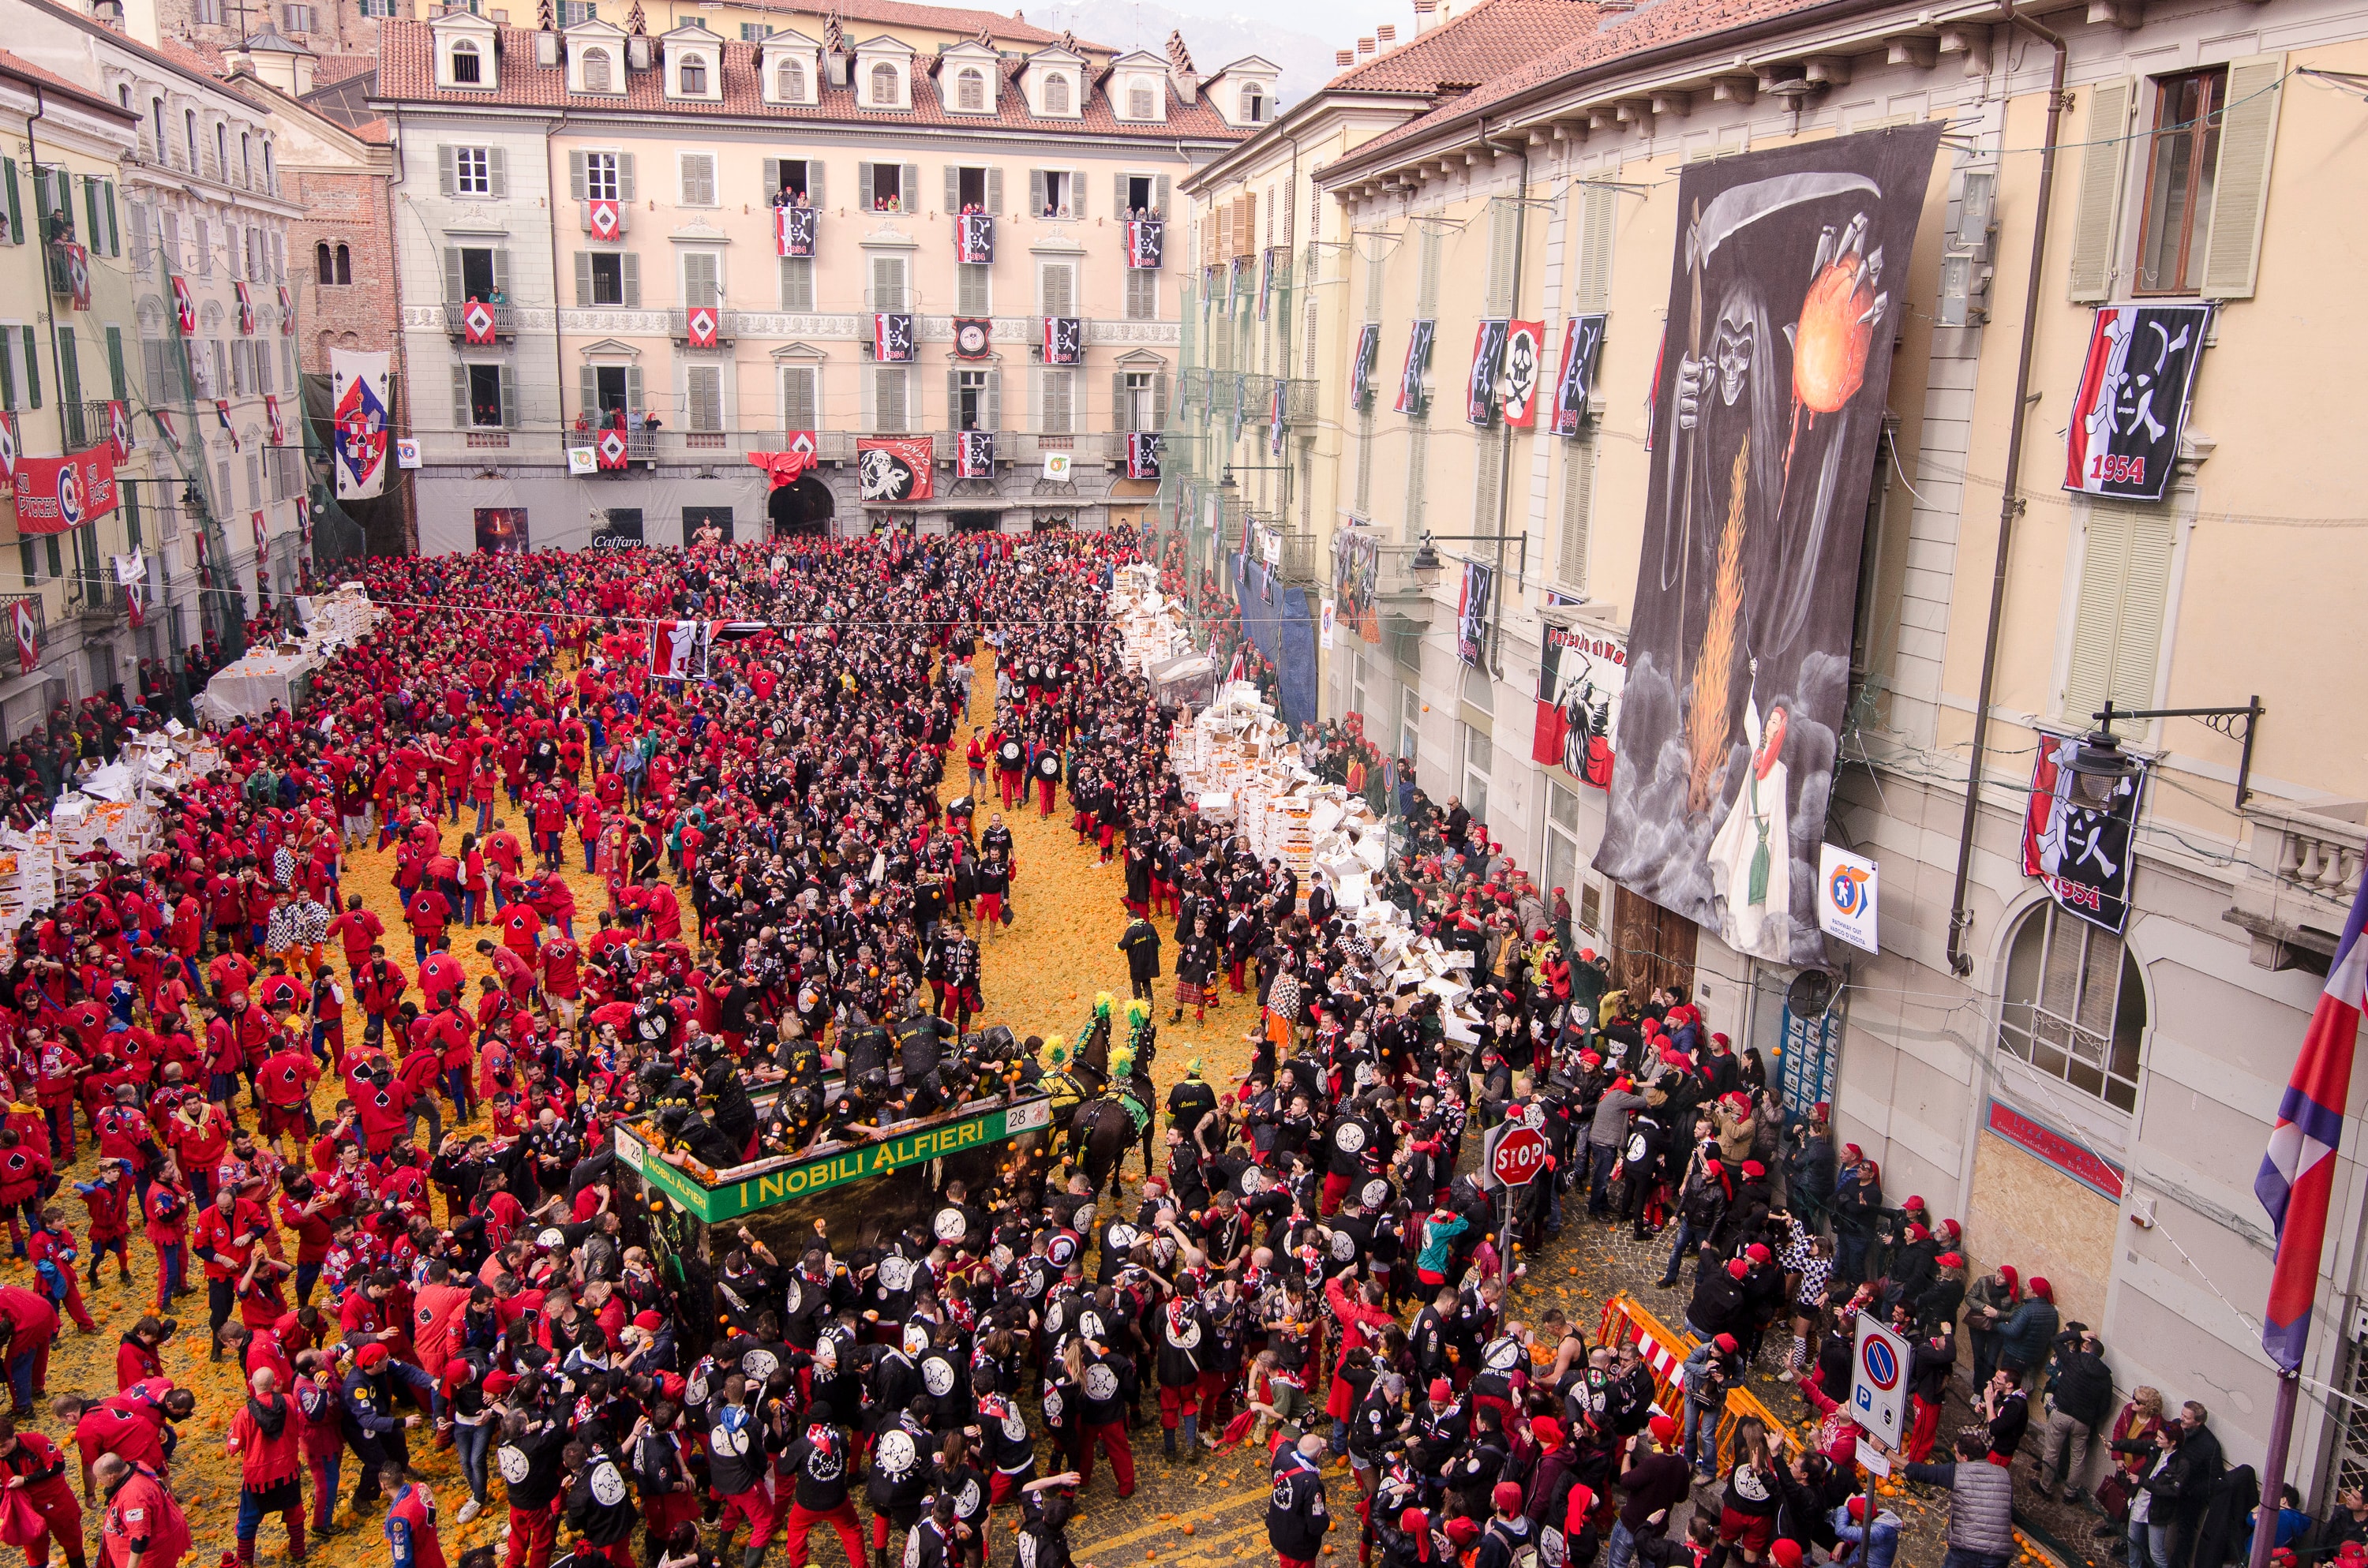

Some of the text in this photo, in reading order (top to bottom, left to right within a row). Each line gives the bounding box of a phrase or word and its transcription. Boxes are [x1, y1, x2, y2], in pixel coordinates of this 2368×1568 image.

[787, 245, 807, 254] 1954
[967, 253, 986, 261] 1954
[886, 350, 905, 359] 1954
[1560, 410, 1578, 428] 1954
[895, 442, 931, 466] FONDO
[901, 452, 927, 485] PIAZZA
[2090, 455, 2145, 485] 1954
[18, 496, 59, 518] PICCHE
[594, 536, 642, 550] Caffaro
[2054, 876, 2100, 911] 1954
[1830, 925, 1845, 937] VARCO
[1831, 918, 1863, 936] PATHWAY OUT
[1010, 1110, 1026, 1128] 28
[631, 1143, 642, 1163] 28
[643, 1154, 648, 1166] I
[1497, 1143, 1542, 1170] STOP
[740, 1182, 749, 1208] I
[1479, 1368, 1513, 1379] ARPE DIE
[1859, 1387, 1870, 1405] P
